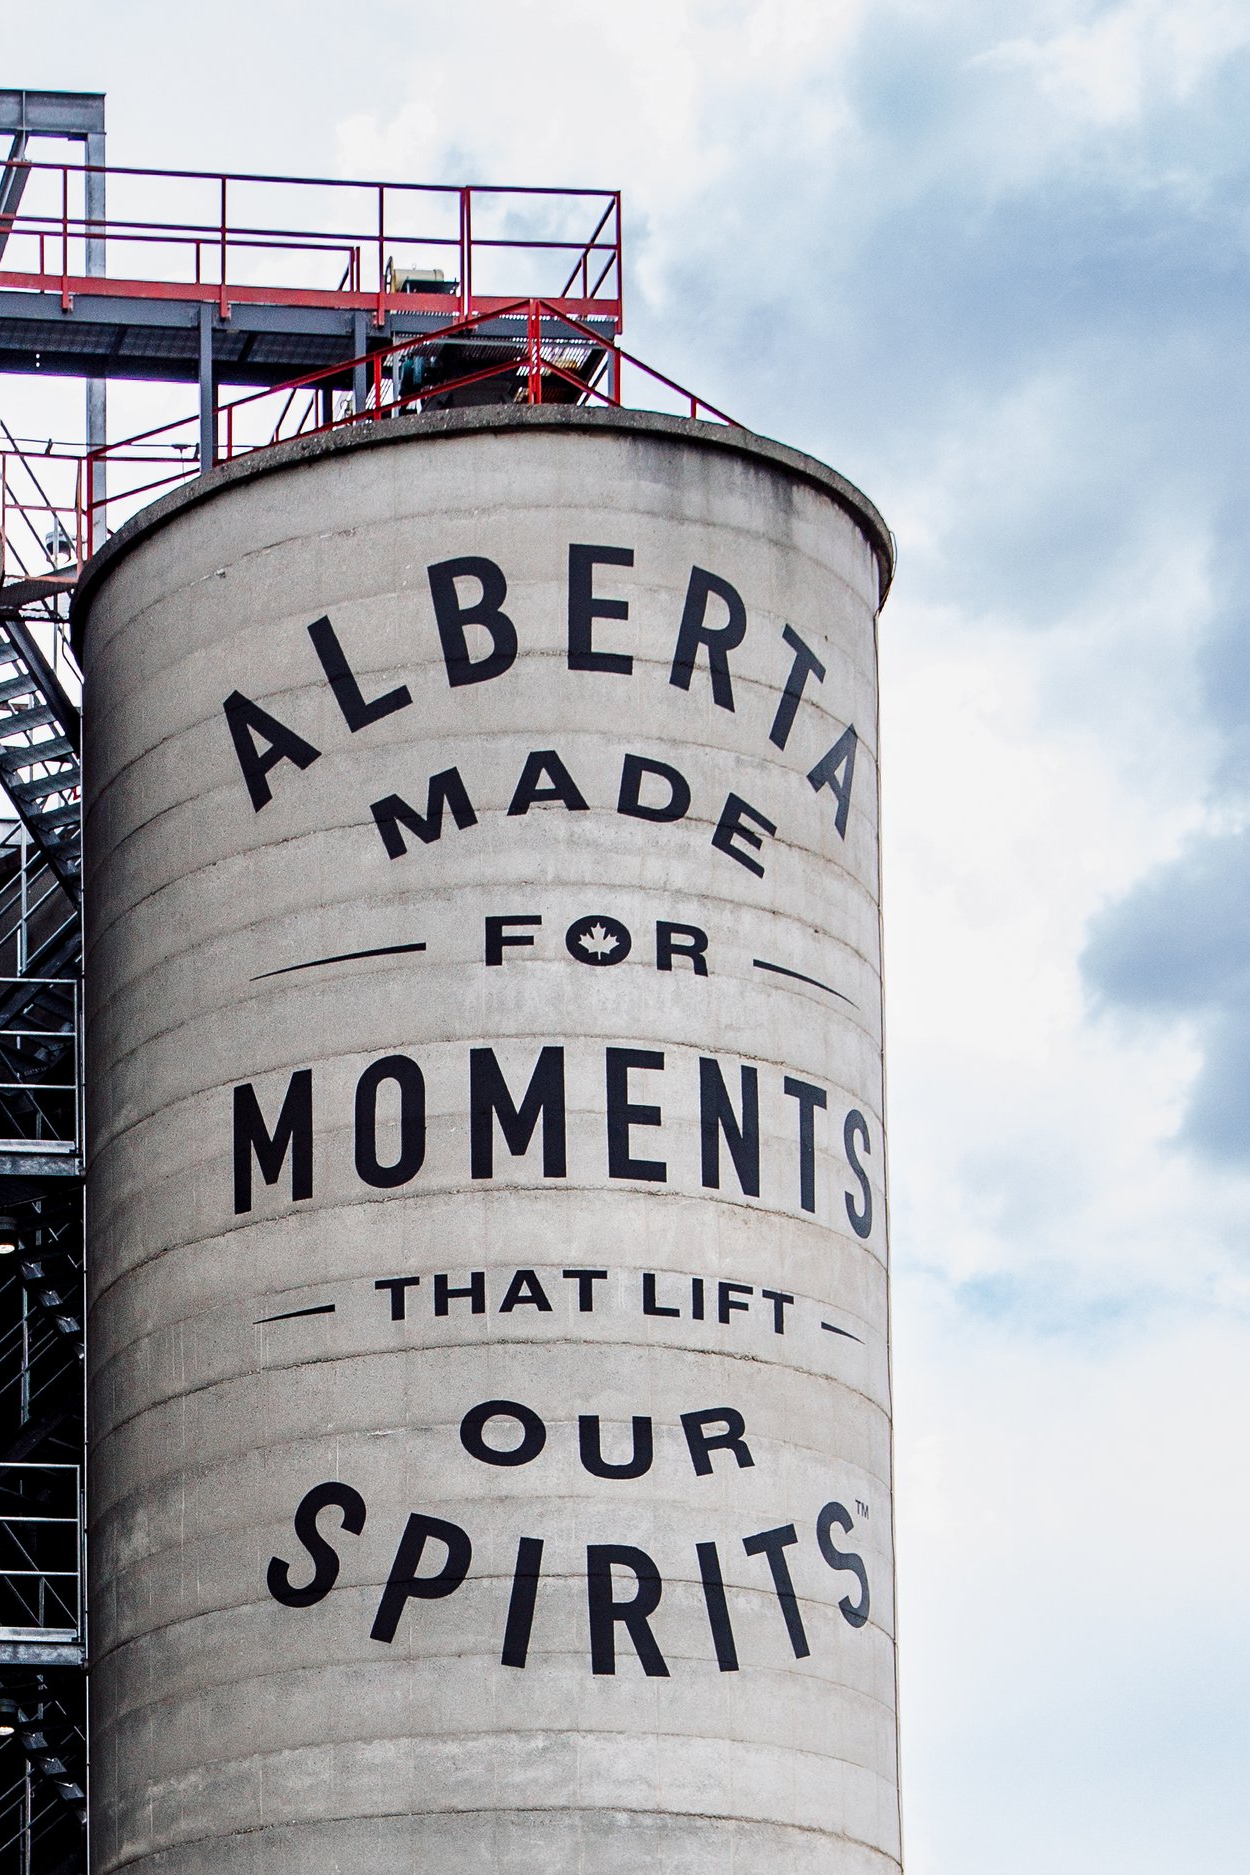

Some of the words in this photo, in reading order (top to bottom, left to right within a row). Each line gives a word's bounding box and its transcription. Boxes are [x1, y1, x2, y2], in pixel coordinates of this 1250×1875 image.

[223, 543, 859, 841] ALBERTA
[369, 749, 778, 880] MADE
[485, 914, 709, 978] FOR
[232, 1045, 873, 1240] MOMENTS
[375, 1269, 608, 1322] THAT
[642, 1272, 795, 1335] LIFT
[460, 1399, 756, 1480] OUR
